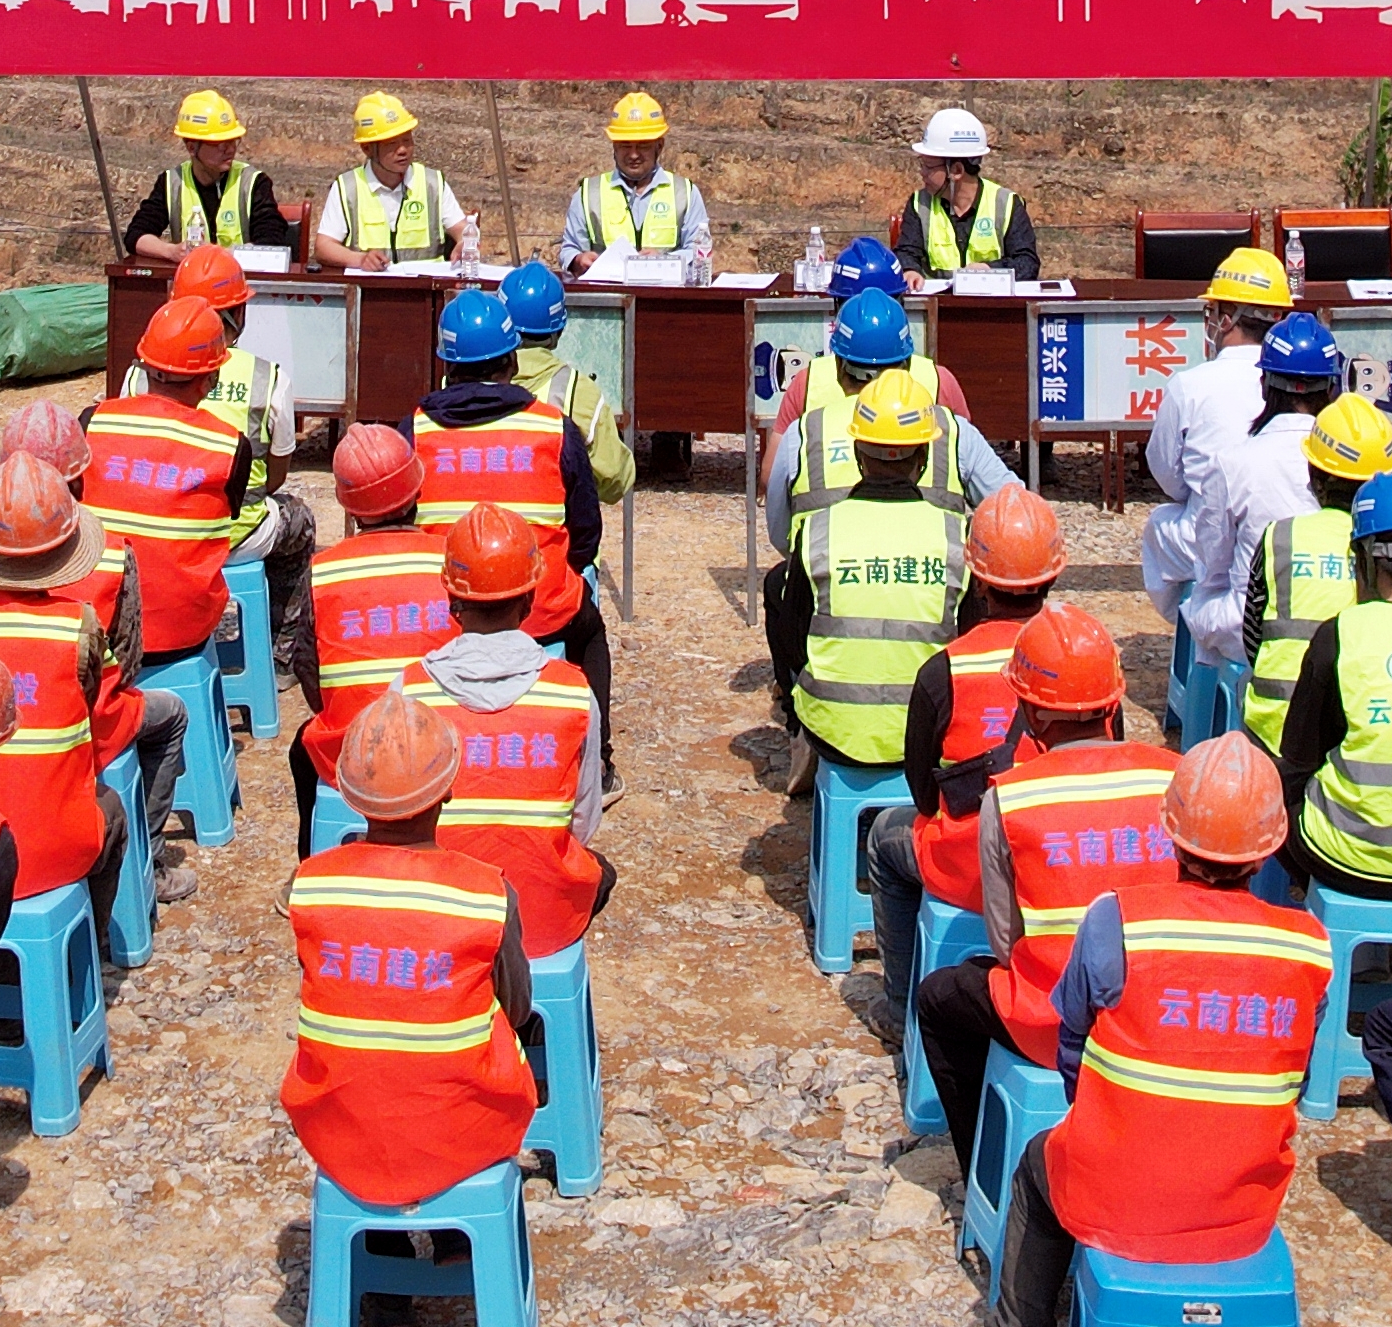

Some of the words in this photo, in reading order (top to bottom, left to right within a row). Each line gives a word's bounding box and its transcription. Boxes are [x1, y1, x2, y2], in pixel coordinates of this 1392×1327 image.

[207, 380, 249, 403] 建投
[105, 456, 205, 491] 云南建投
[434, 445, 534, 474] 云南建投
[836, 555, 947, 586] 云南建投
[340, 600, 452, 639] 云南建投
[465, 733, 557, 768] 南建投
[1042, 826, 1175, 868] 云南建投
[317, 940, 454, 990] 云南建投
[1158, 988, 1298, 1039] 云南建投
